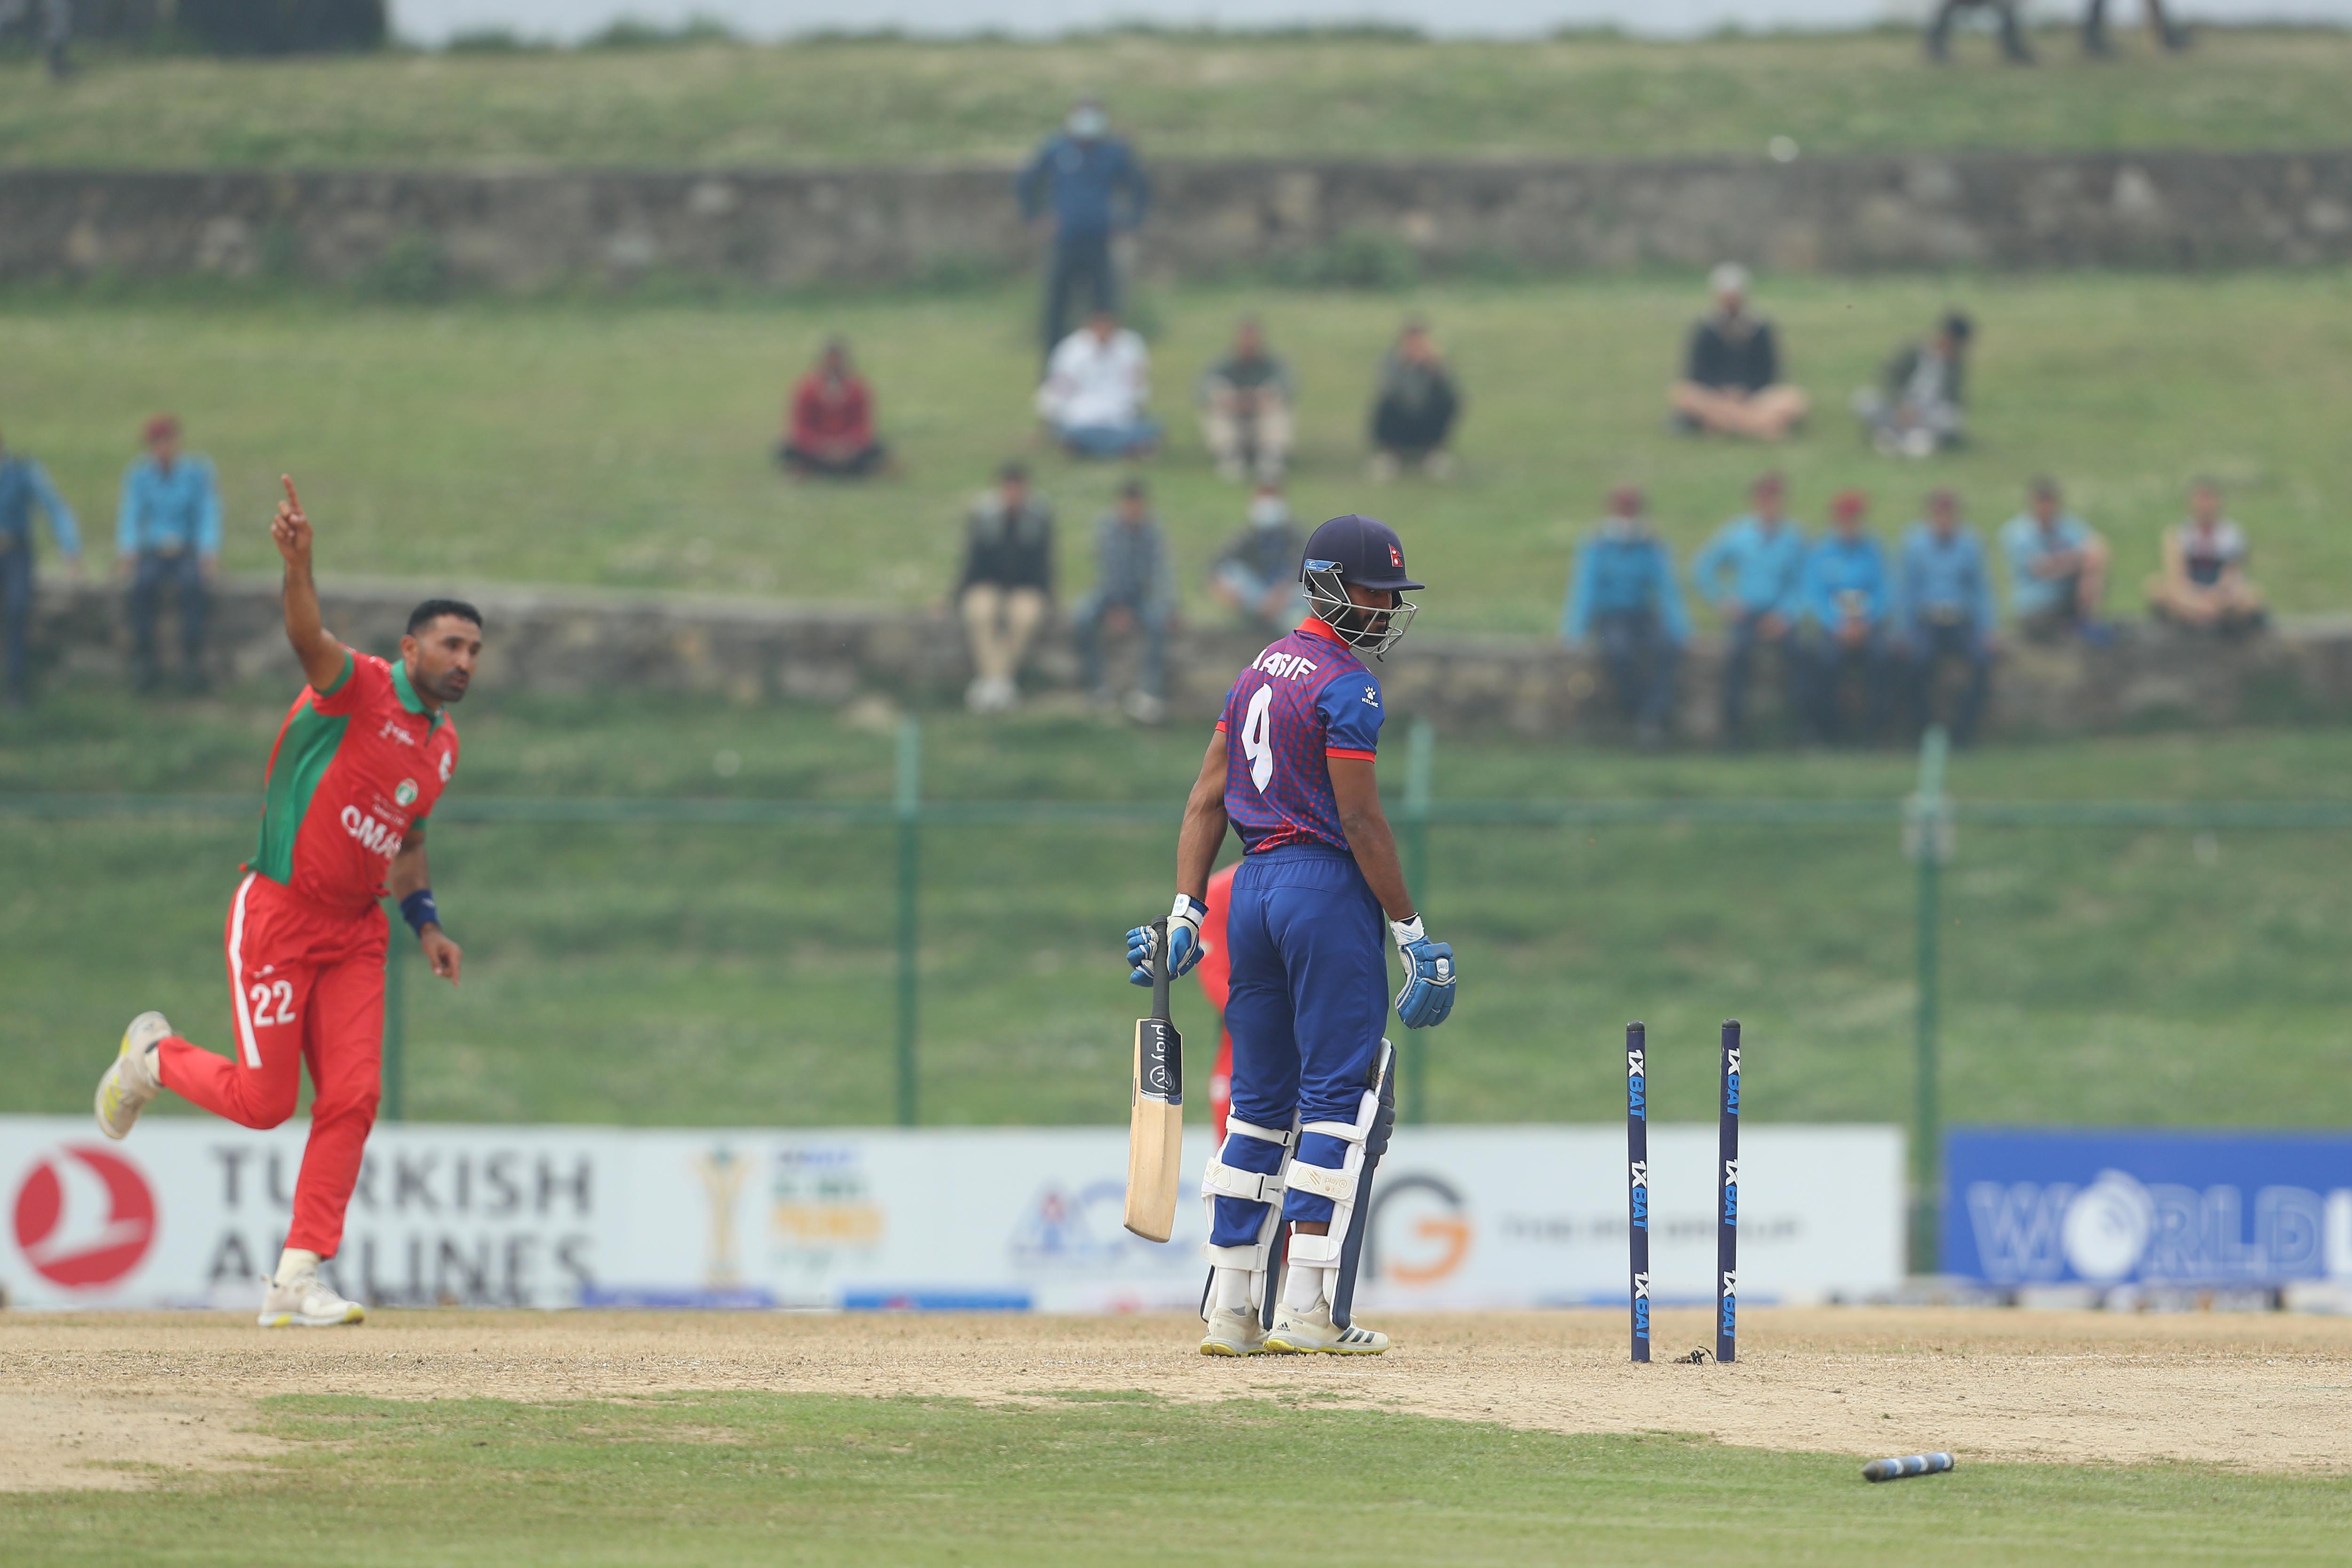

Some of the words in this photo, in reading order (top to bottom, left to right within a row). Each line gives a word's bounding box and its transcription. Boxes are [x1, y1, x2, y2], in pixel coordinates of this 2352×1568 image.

[1241, 682, 1273, 795] 9
[1361, 697, 1379, 708] KELME
[250, 980, 296, 1027] 22
[1628, 1049, 1645, 1121] 1XBAT
[1727, 1048, 1741, 1119] 1XBAT
[1631, 1160, 1648, 1232] 1XBAT
[1725, 1158, 1738, 1230] 1XBAT
[207, 1229, 597, 1308] ALINES
[1634, 1271, 1650, 1343] 1XBAT
[1722, 1270, 1736, 1342] 1XBAT
